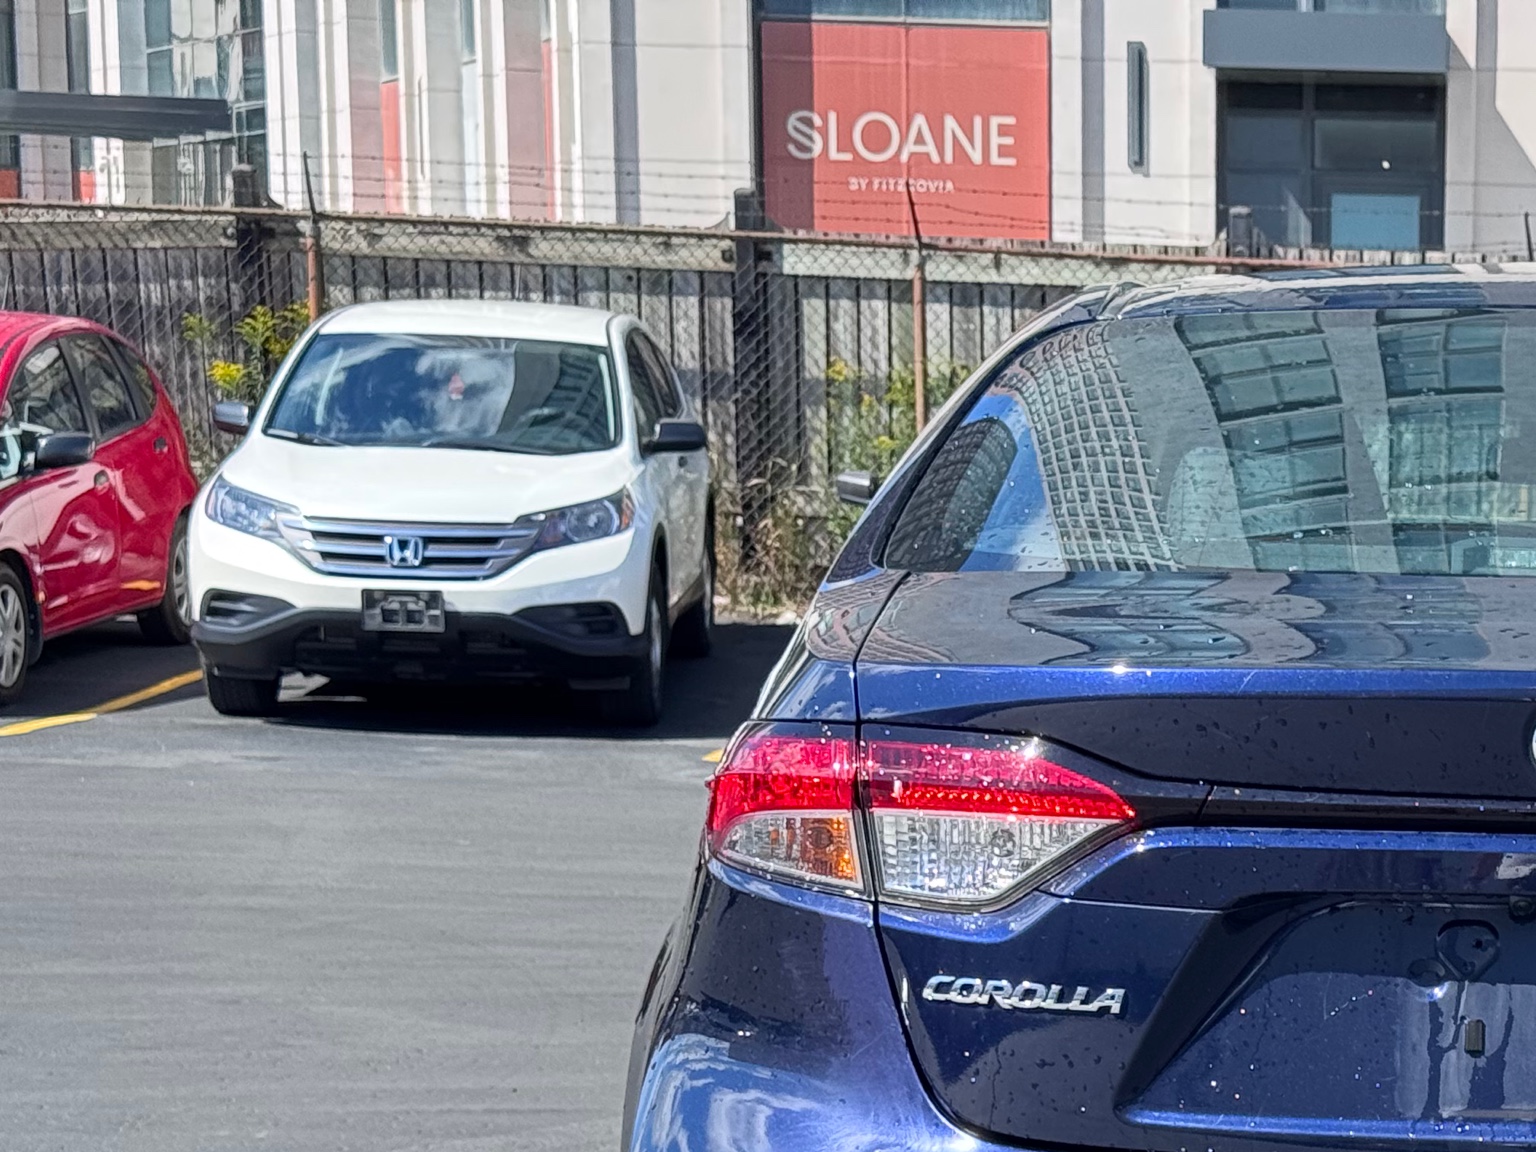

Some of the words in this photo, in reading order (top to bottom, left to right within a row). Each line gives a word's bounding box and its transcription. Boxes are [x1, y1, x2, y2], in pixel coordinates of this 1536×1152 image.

[787, 109, 1018, 167] SLOANE
[847, 176, 869, 192] BY
[921, 974, 1126, 1015] COROLLA
